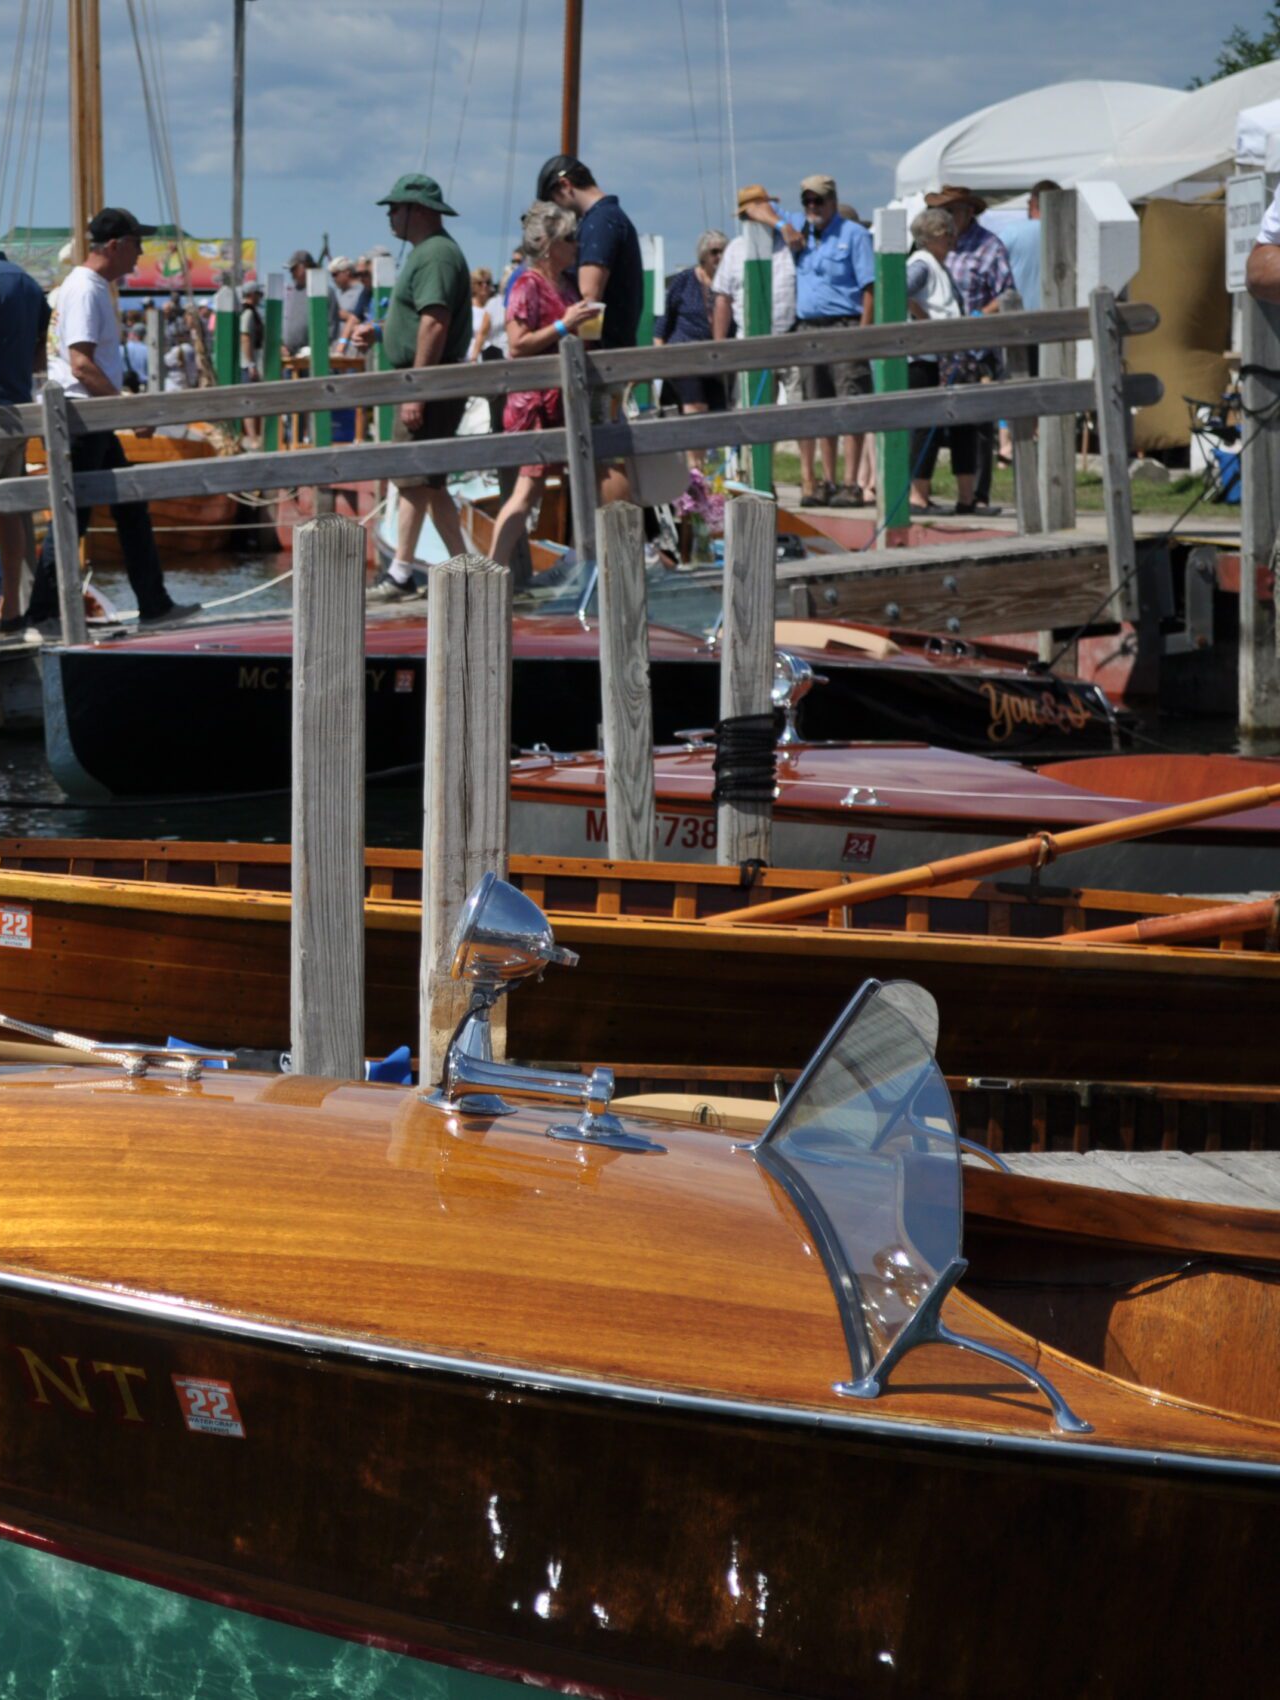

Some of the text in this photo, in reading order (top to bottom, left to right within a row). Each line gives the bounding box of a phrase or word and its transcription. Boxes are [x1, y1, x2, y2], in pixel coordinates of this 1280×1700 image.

[238, 667, 278, 691] MC
[848, 838, 870, 854] 24
[1, 912, 28, 937] 22
[17, 1346, 148, 1422] NT
[185, 1388, 232, 1420] 22
